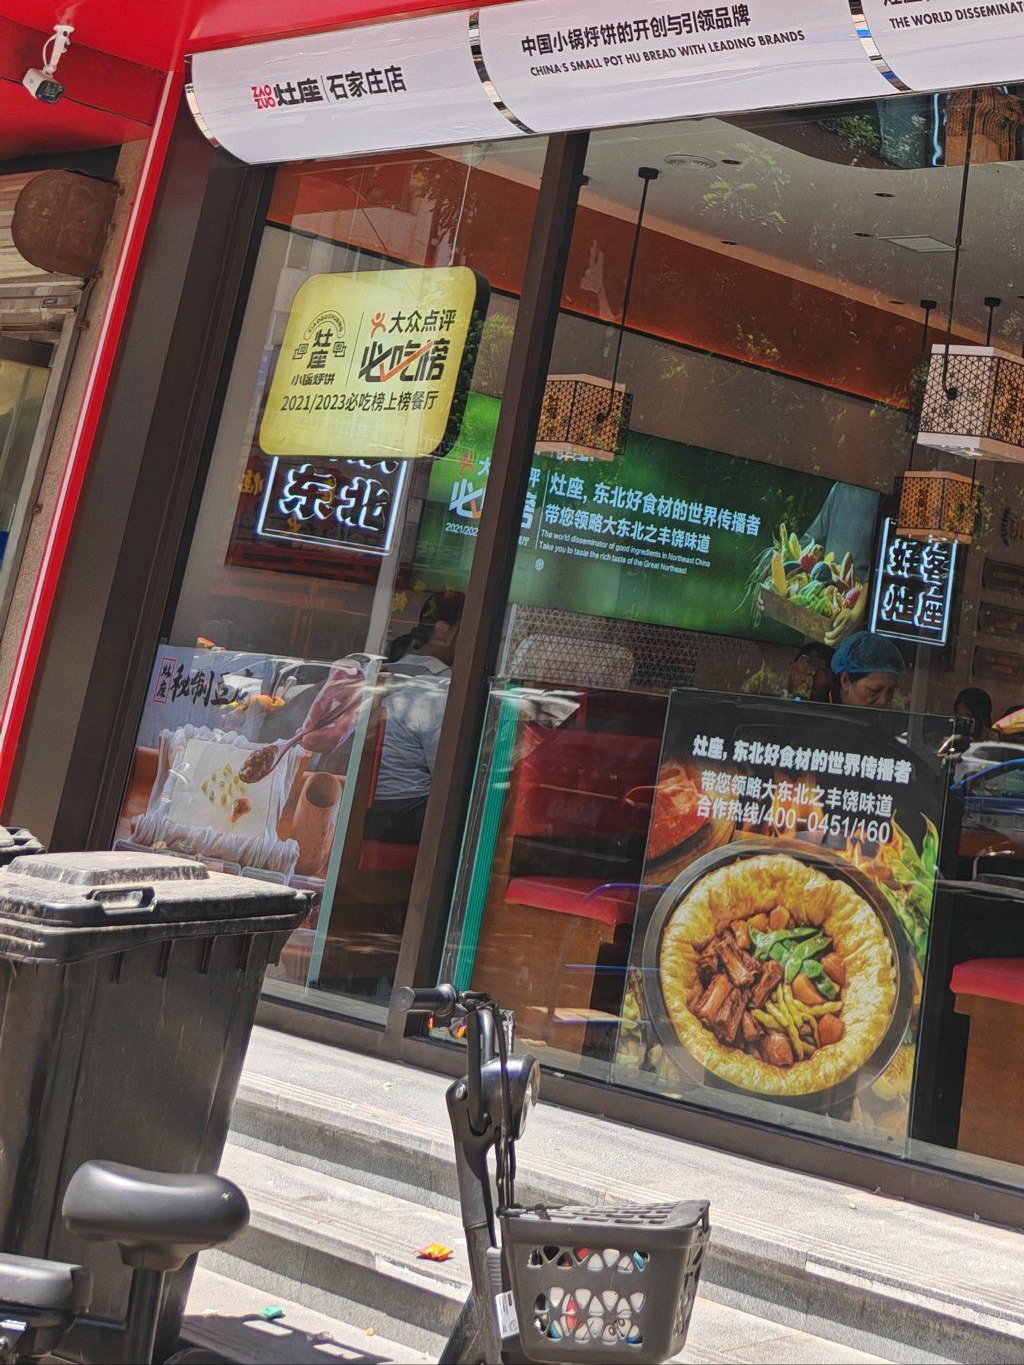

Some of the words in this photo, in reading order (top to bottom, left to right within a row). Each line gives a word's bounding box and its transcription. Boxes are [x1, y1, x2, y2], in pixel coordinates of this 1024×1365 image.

[521, 3, 750, 57] 中国小锅烀饼的开创与引领品牌
[889, 17, 911, 29] THE
[911, 11, 953, 27] WORLD
[530, 63, 569, 76] CHINA'S
[570, 58, 603, 71] SMALL
[603, 55, 623, 66] POT
[624, 53, 641, 64] HU
[643, 48, 676, 61] BREAD
[678, 44, 707, 56] WITH
[708, 37, 756, 53] LEADING
[758, 30, 805, 46] BRANDS
[251, 84, 272, 98] ZAO
[273, 77, 324, 107] 灶座
[326, 65, 407, 101] 石家庄店
[255, 97, 276, 109] ZUO
[389, 308, 457, 334] 大众点评
[306, 328, 333, 369] 灶座
[358, 338, 450, 383] 必吃榜
[280, 390, 439, 413] 2021/2023必吃榜上榜餐厅
[545, 503, 711, 554] 带您领略大东北之丰饶味道
[553, 533, 570, 542] world
[616, 544, 629, 553] good
[539, 541, 554, 551] Take
[554, 545, 566, 553] you
[700, 770, 893, 818] 带您领略大东北之丰饶味道
